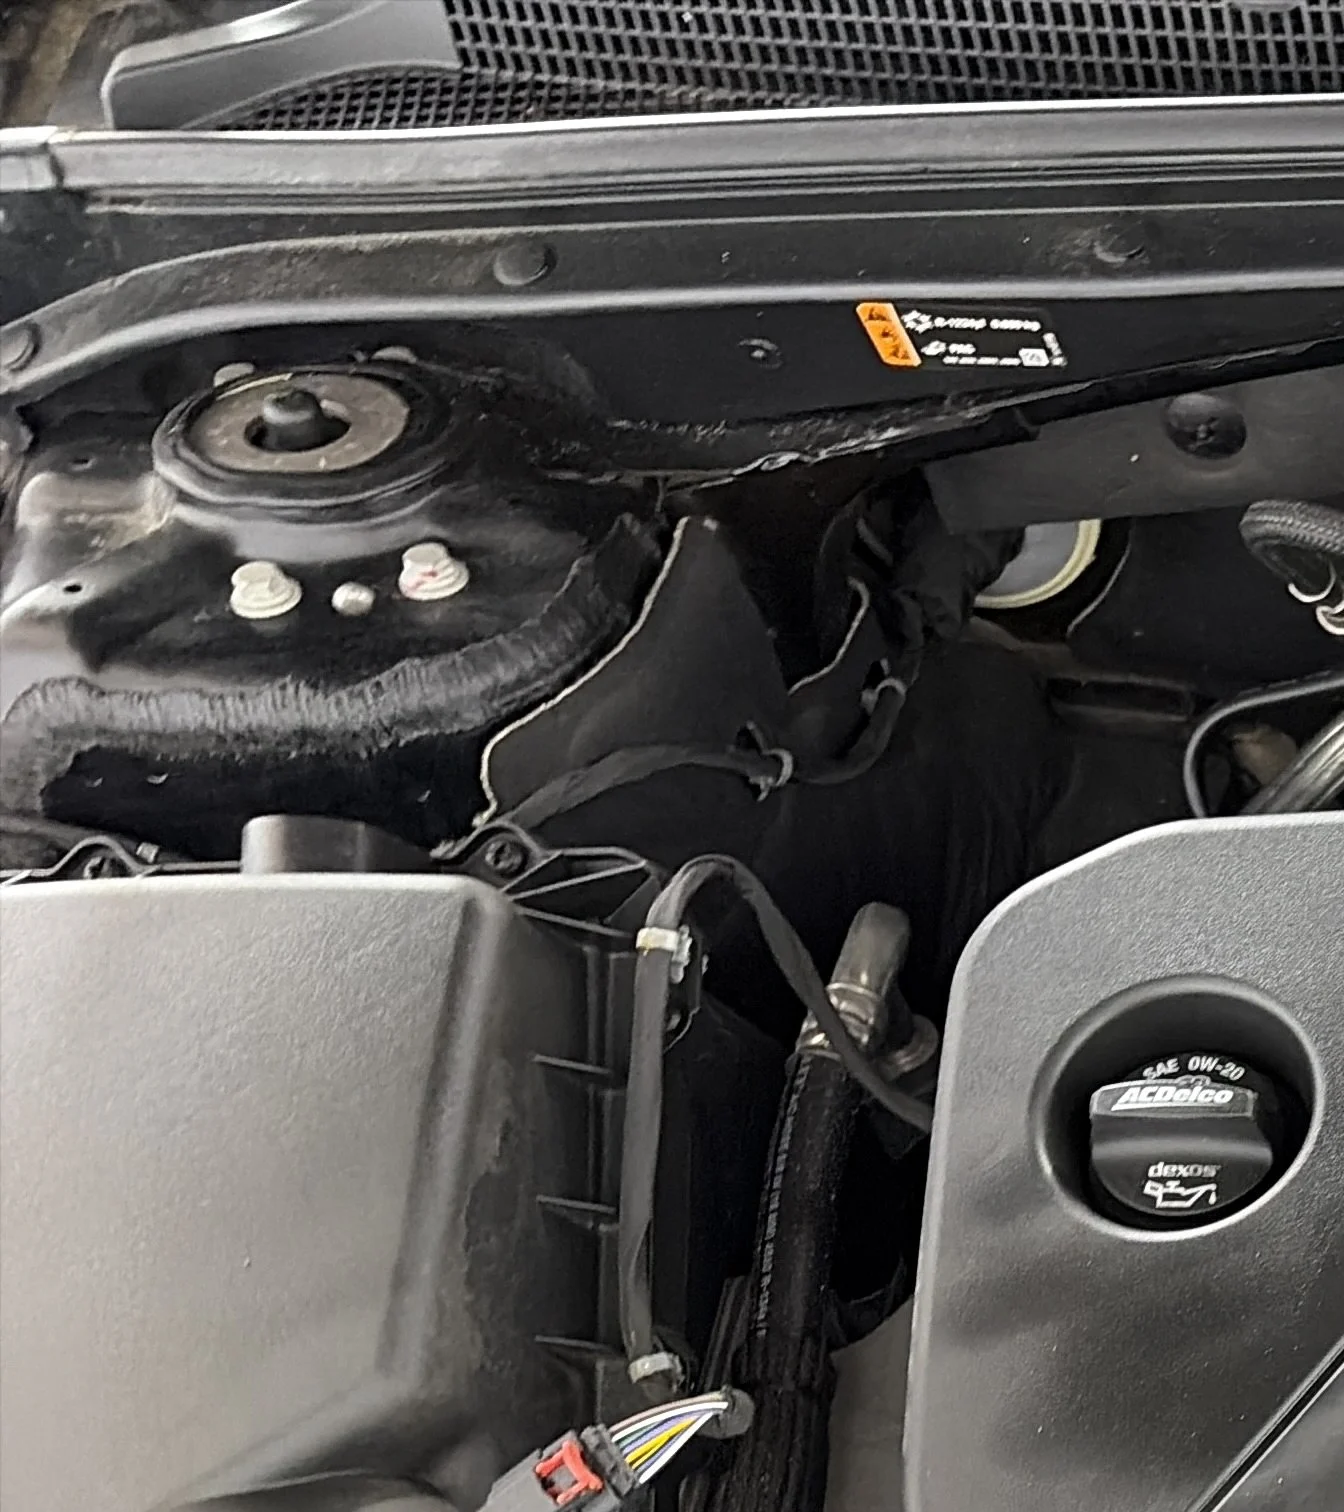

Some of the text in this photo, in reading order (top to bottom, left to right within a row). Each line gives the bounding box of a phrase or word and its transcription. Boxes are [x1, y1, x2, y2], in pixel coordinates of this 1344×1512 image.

[1143, 1055, 1246, 1081] SAE 0W-20
[1111, 1086, 1234, 1111] ACDelco
[1148, 1162, 1216, 1178] dexos
